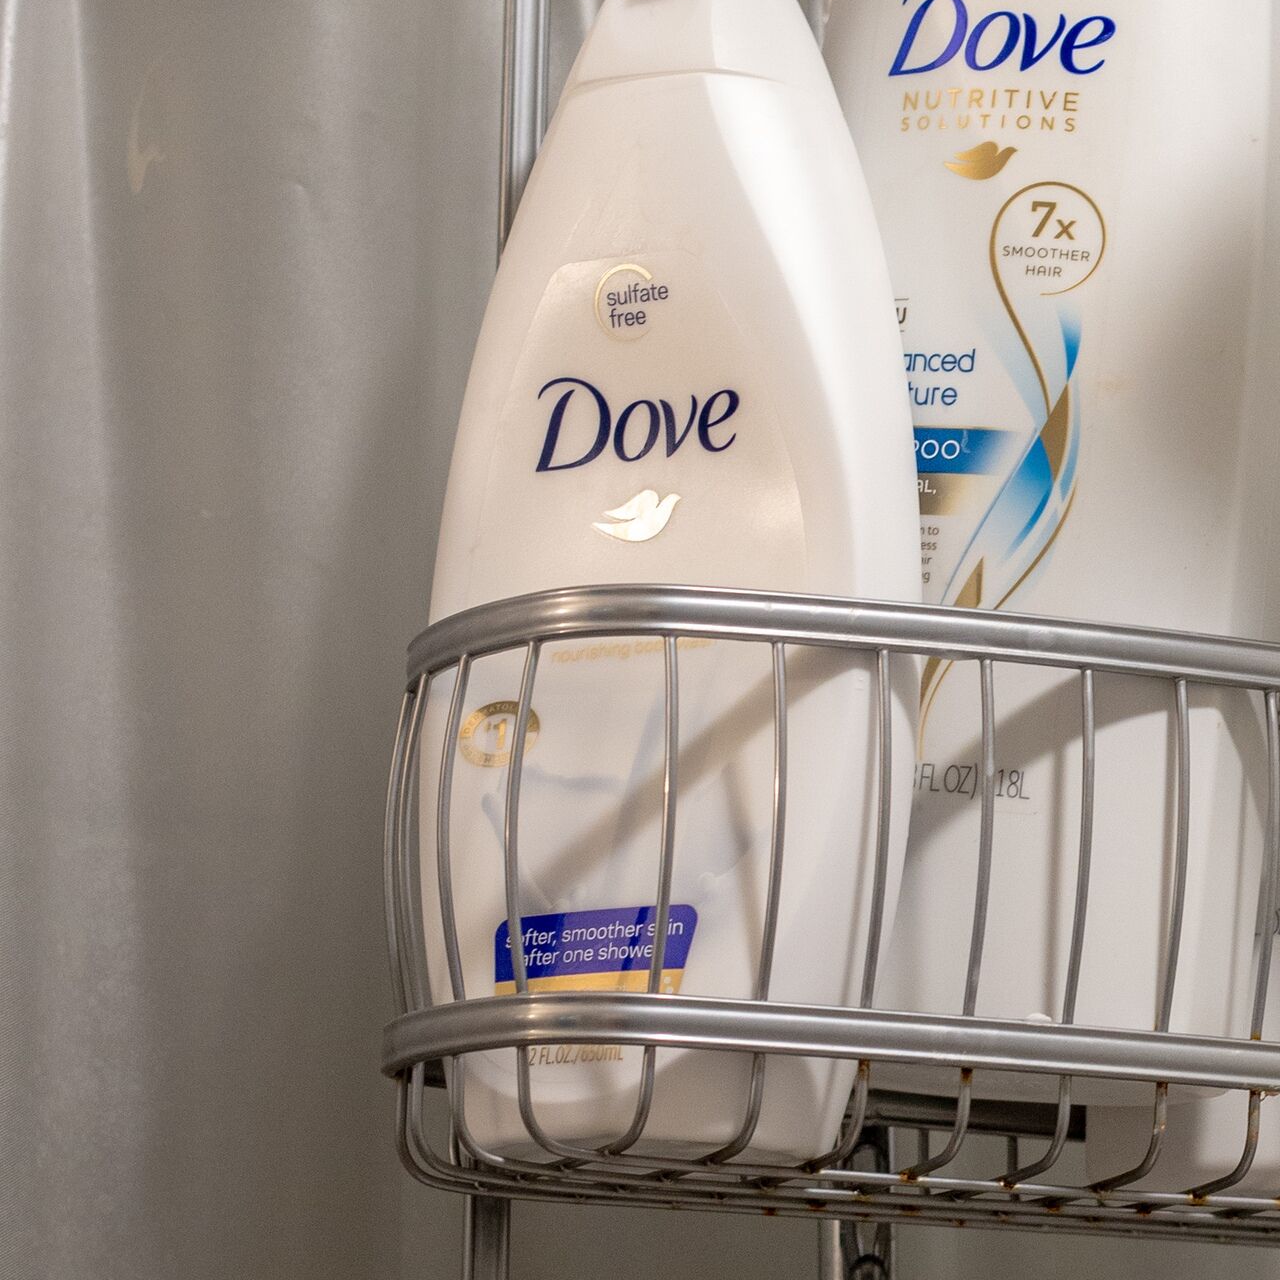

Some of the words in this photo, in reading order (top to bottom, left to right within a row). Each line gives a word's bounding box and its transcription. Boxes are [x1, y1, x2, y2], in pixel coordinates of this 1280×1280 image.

[903, 87, 1080, 112] NUTRITIVE
[901, 114, 1076, 133] SOLUTIONS
[1031, 200, 1077, 241] 7x
[1002, 245, 1091, 262] SMOOTHER
[1025, 264, 1063, 278] HAIR
[606, 282, 669, 307] sulfate
[609, 308, 647, 329] free
[535, 376, 741, 473] Dove
[943, 763, 978, 800] OZ)
[561, 921, 643, 943] smoother
[647, 919, 684, 937] sin
[562, 948, 594, 963] one
[598, 942, 653, 961] showe
